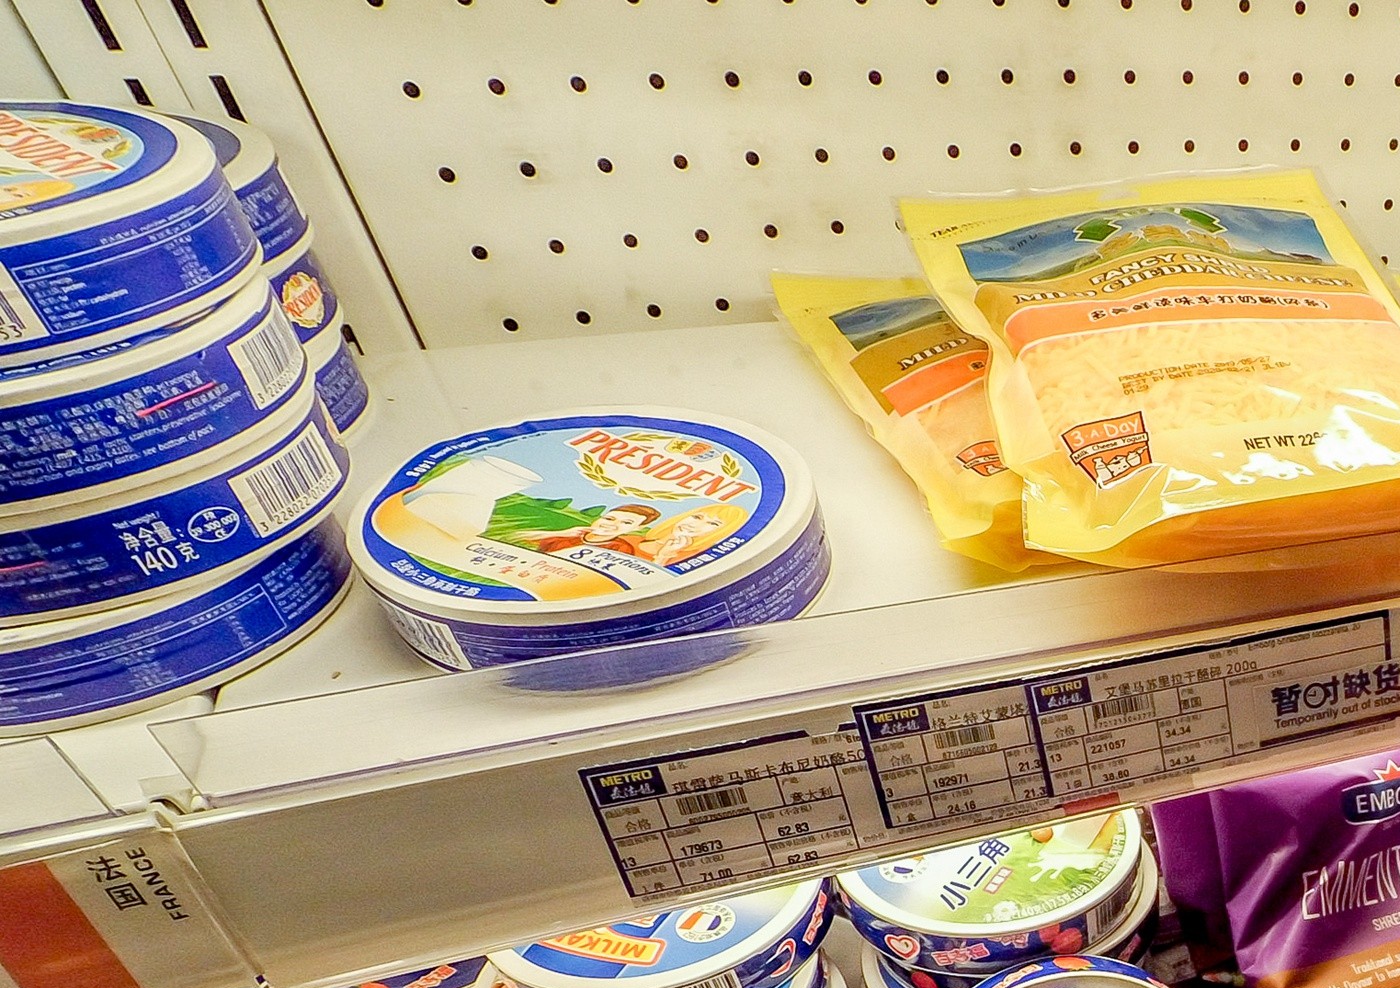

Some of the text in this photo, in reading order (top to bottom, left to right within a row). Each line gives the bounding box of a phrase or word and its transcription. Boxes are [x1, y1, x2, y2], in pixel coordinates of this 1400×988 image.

[1091, 252, 1178, 286] FANCY
[1102, 261, 1240, 294] CHEDDAR
[900, 335, 967, 371] MILD
[1119, 361, 1209, 383] PRODUCTION DATE
[1168, 370, 1194, 380] DATE
[1091, 440, 1118, 451] Cheese
[1121, 432, 1147, 445] Yogurt
[1243, 435, 1296, 452] NET WT
[570, 430, 757, 503] PRÉSIDENT
[260, 521, 270, 533] 3
[130, 546, 179, 577] 140
[175, 541, 201, 563] 克
[465, 541, 579, 580] Calcium Protein
[570, 547, 656, 577] 8 Portions
[1040, 679, 1083, 697] METRO
[872, 707, 920, 724] METRO
[1274, 708, 1340, 729] Temporarily
[1342, 704, 1360, 717] out
[1362, 700, 1373, 712] of
[1165, 725, 1192, 738] 34.34
[1050, 752, 1063, 764] 13
[1169, 754, 1196, 768] 34.34
[600, 769, 653, 788] METRO
[932, 773, 970, 789] 192971
[789, 786, 834, 803] 意大利
[946, 800, 977, 815] 24.16
[777, 822, 810, 837] 62.83
[679, 839, 724, 857] 179673
[620, 857, 638, 869] 13
[787, 850, 819, 865] 62.83
[85, 854, 149, 912] 法国
[124, 846, 190, 921] FRANCE
[699, 868, 734, 882] 71.00
[939, 838, 1012, 911] 小三角
